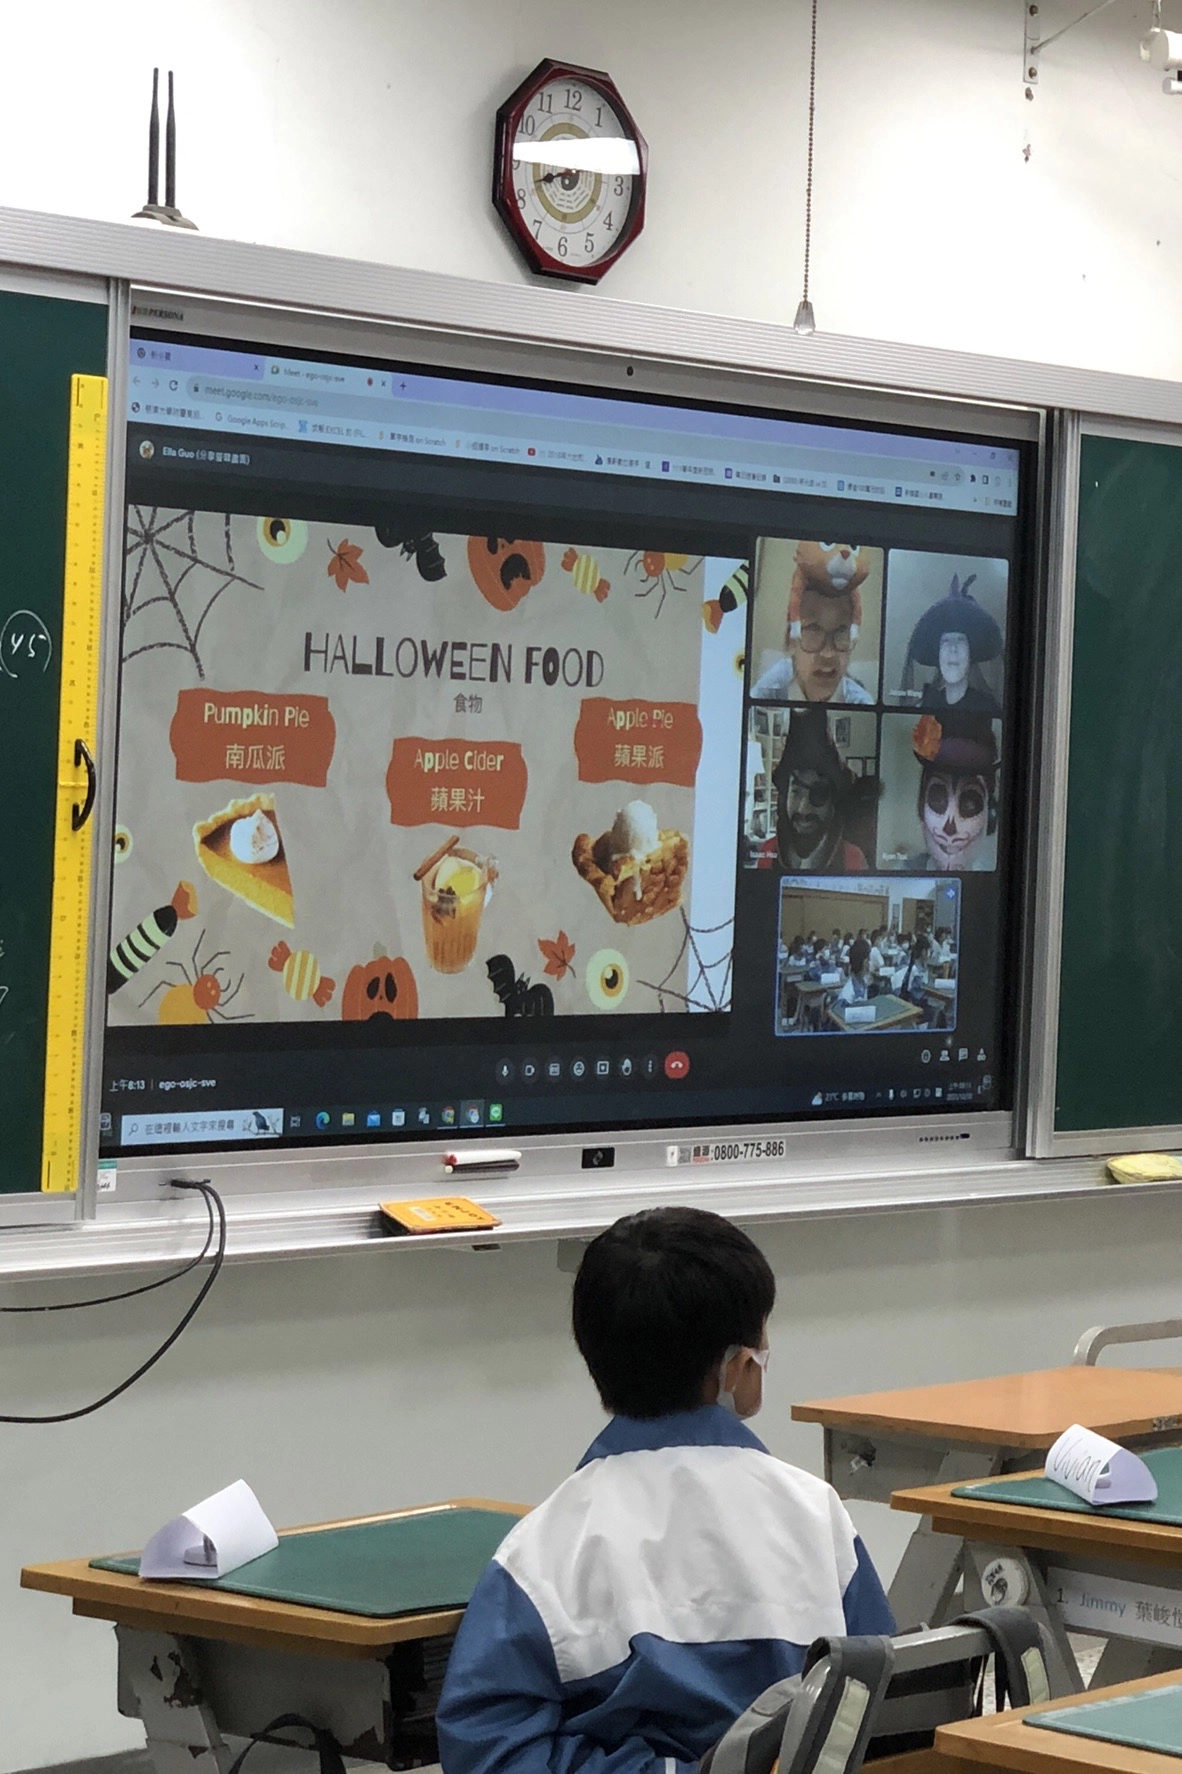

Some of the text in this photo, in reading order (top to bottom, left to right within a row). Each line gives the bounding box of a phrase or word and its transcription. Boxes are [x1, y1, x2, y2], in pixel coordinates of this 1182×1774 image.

[537, 91, 553, 114] 11
[564, 88, 583, 111] 12
[518, 115, 535, 136] 10
[594, 107, 603, 128] 1
[613, 176, 624, 196] 3
[516, 188, 527, 210] 8
[532, 219, 543, 240] 7
[602, 210, 613, 231] 4
[557, 236, 568, 257] 6
[584, 232, 595, 253] 5
[228, 414, 251, 426] Google
[252, 417, 268, 429] Apps
[163, 447, 177, 457] Ella
[178, 448, 194, 459] Guo
[303, 631, 604, 688] HALLOWEEN FOOD
[453, 693, 483, 715] 食物
[203, 702, 310, 729] Pumpkin Pie
[607, 707, 674, 730] Apple Pie
[225, 743, 286, 770] 南瓜派
[414, 749, 504, 773] Apple Cider
[614, 743, 665, 769] 蘋果派
[431, 787, 486, 814] 蘋果汁
[1079, 1593, 1127, 1618] Jimmy
